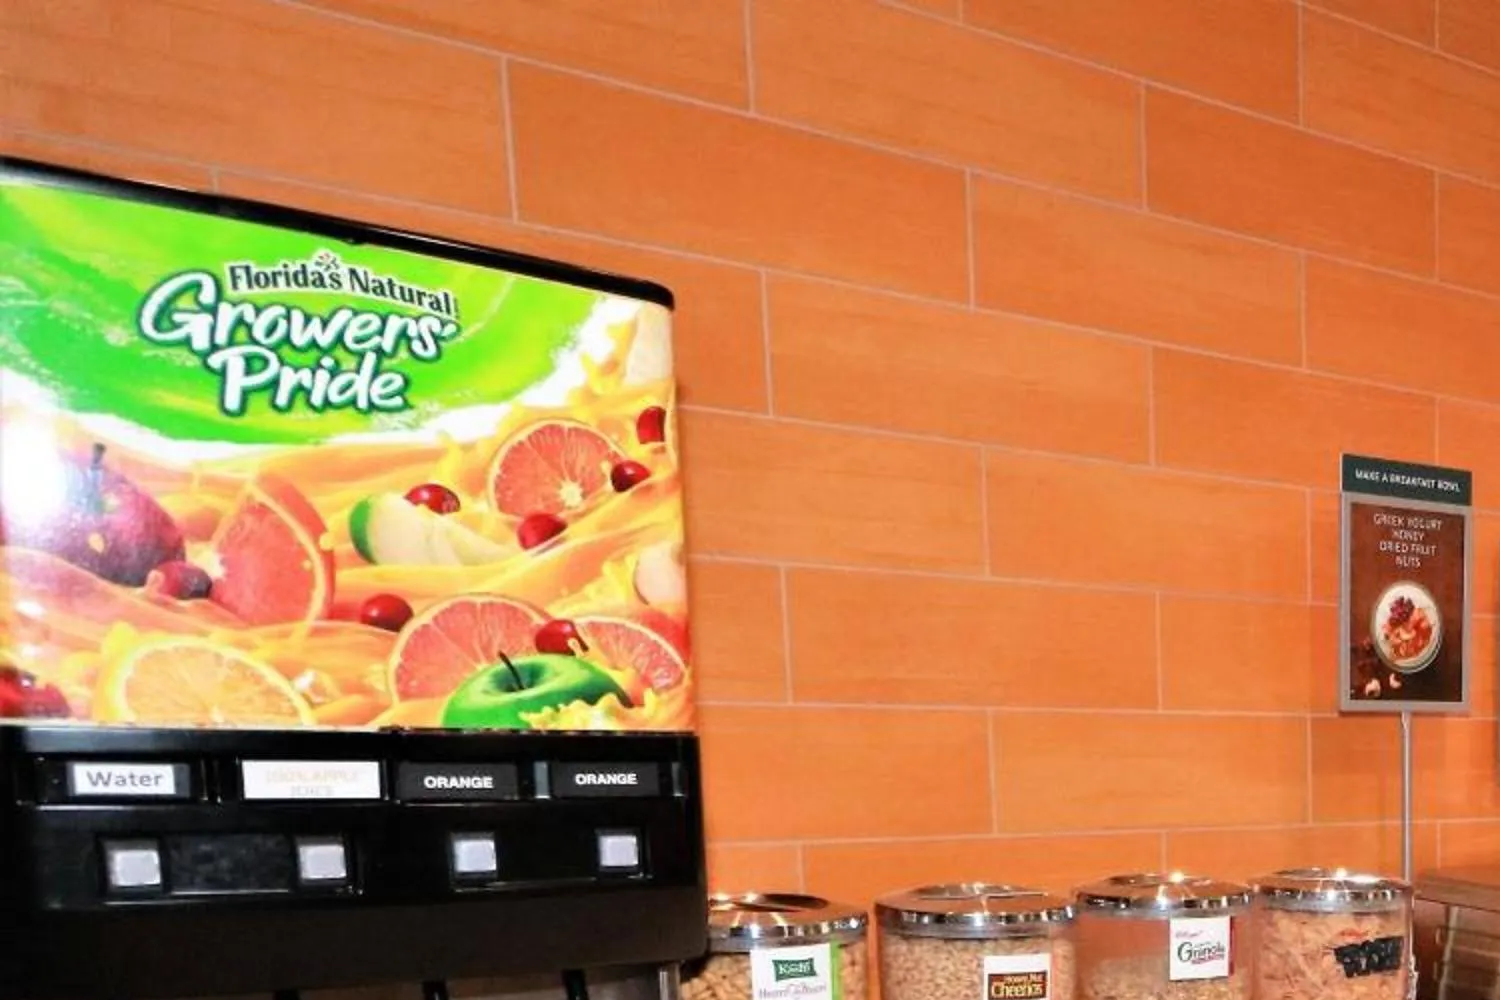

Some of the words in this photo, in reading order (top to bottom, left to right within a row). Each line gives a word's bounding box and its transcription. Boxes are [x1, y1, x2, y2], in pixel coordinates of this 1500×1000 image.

[206, 345, 412, 416] Pride
[1355, 468, 1380, 482] MAKE
[1389, 474, 1435, 489] BREAKFAST
[1437, 480, 1461, 493] BOWL
[1373, 512, 1405, 527] GREEK
[1379, 541, 1409, 554] DRIED
[1411, 544, 1437, 557] FRUIT
[86, 770, 164, 788] Water
[423, 775, 494, 789] ORANGE
[575, 773, 638, 785] ORANGE
